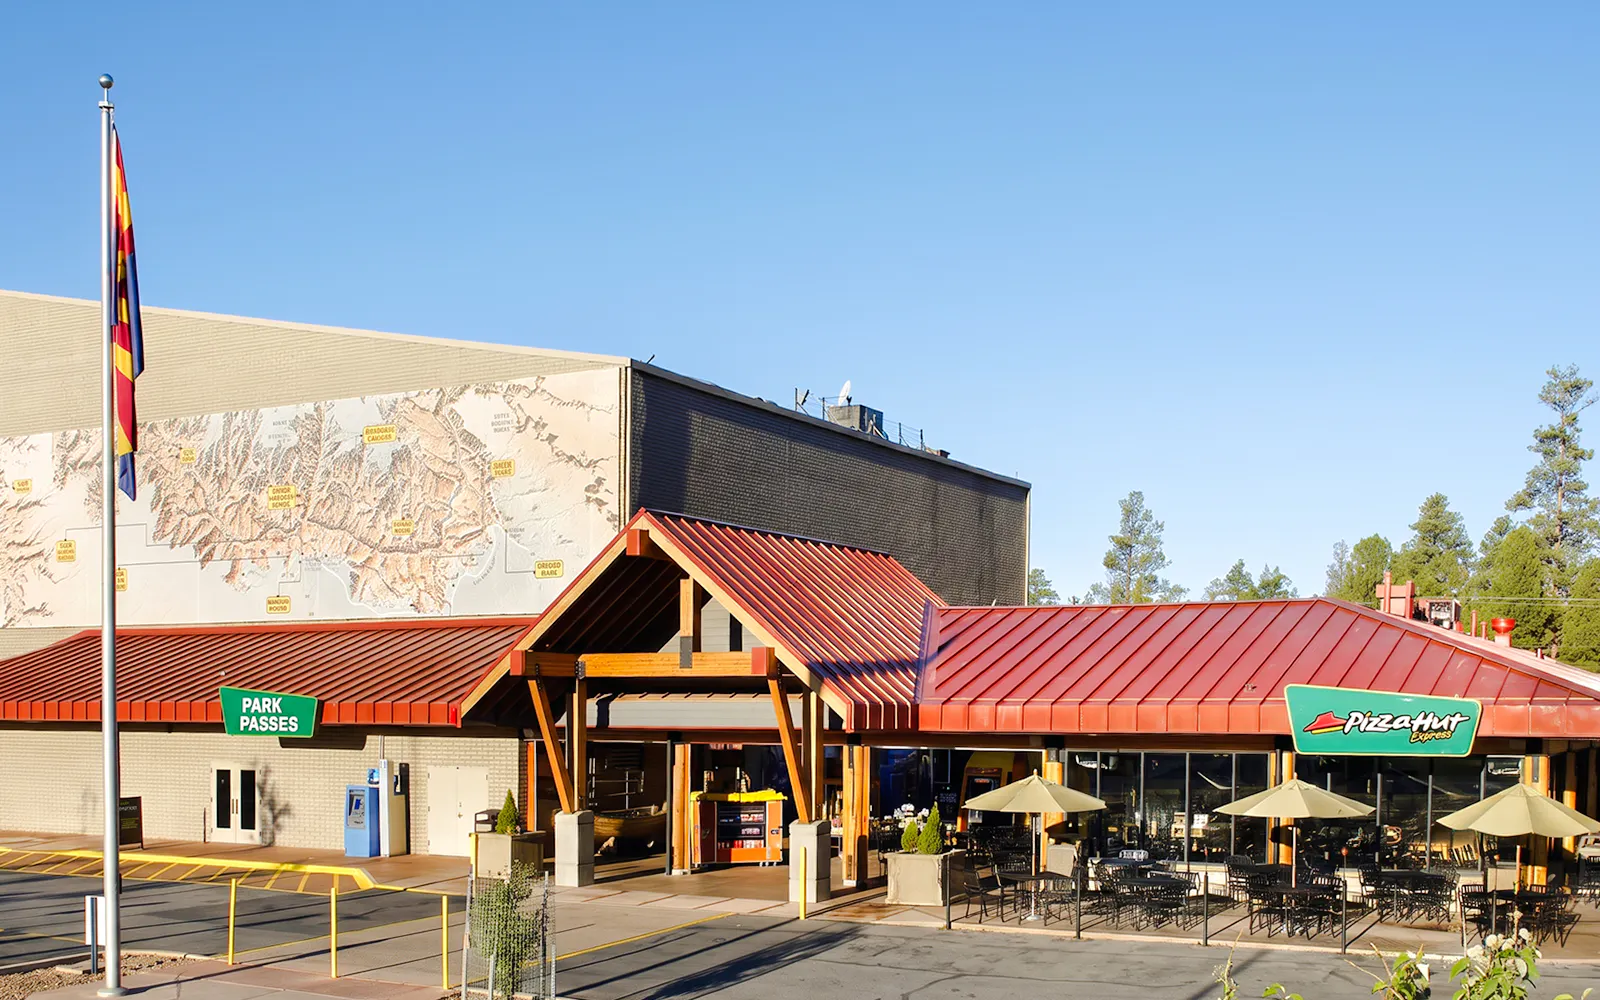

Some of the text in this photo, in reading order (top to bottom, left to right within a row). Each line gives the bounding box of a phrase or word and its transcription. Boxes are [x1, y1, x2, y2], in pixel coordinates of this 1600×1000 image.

[242, 697, 282, 713] PARK
[240, 716, 298, 732] PASSES
[1344, 711, 1470, 734] Pizza Hut
[1409, 731, 1453, 744] Express
